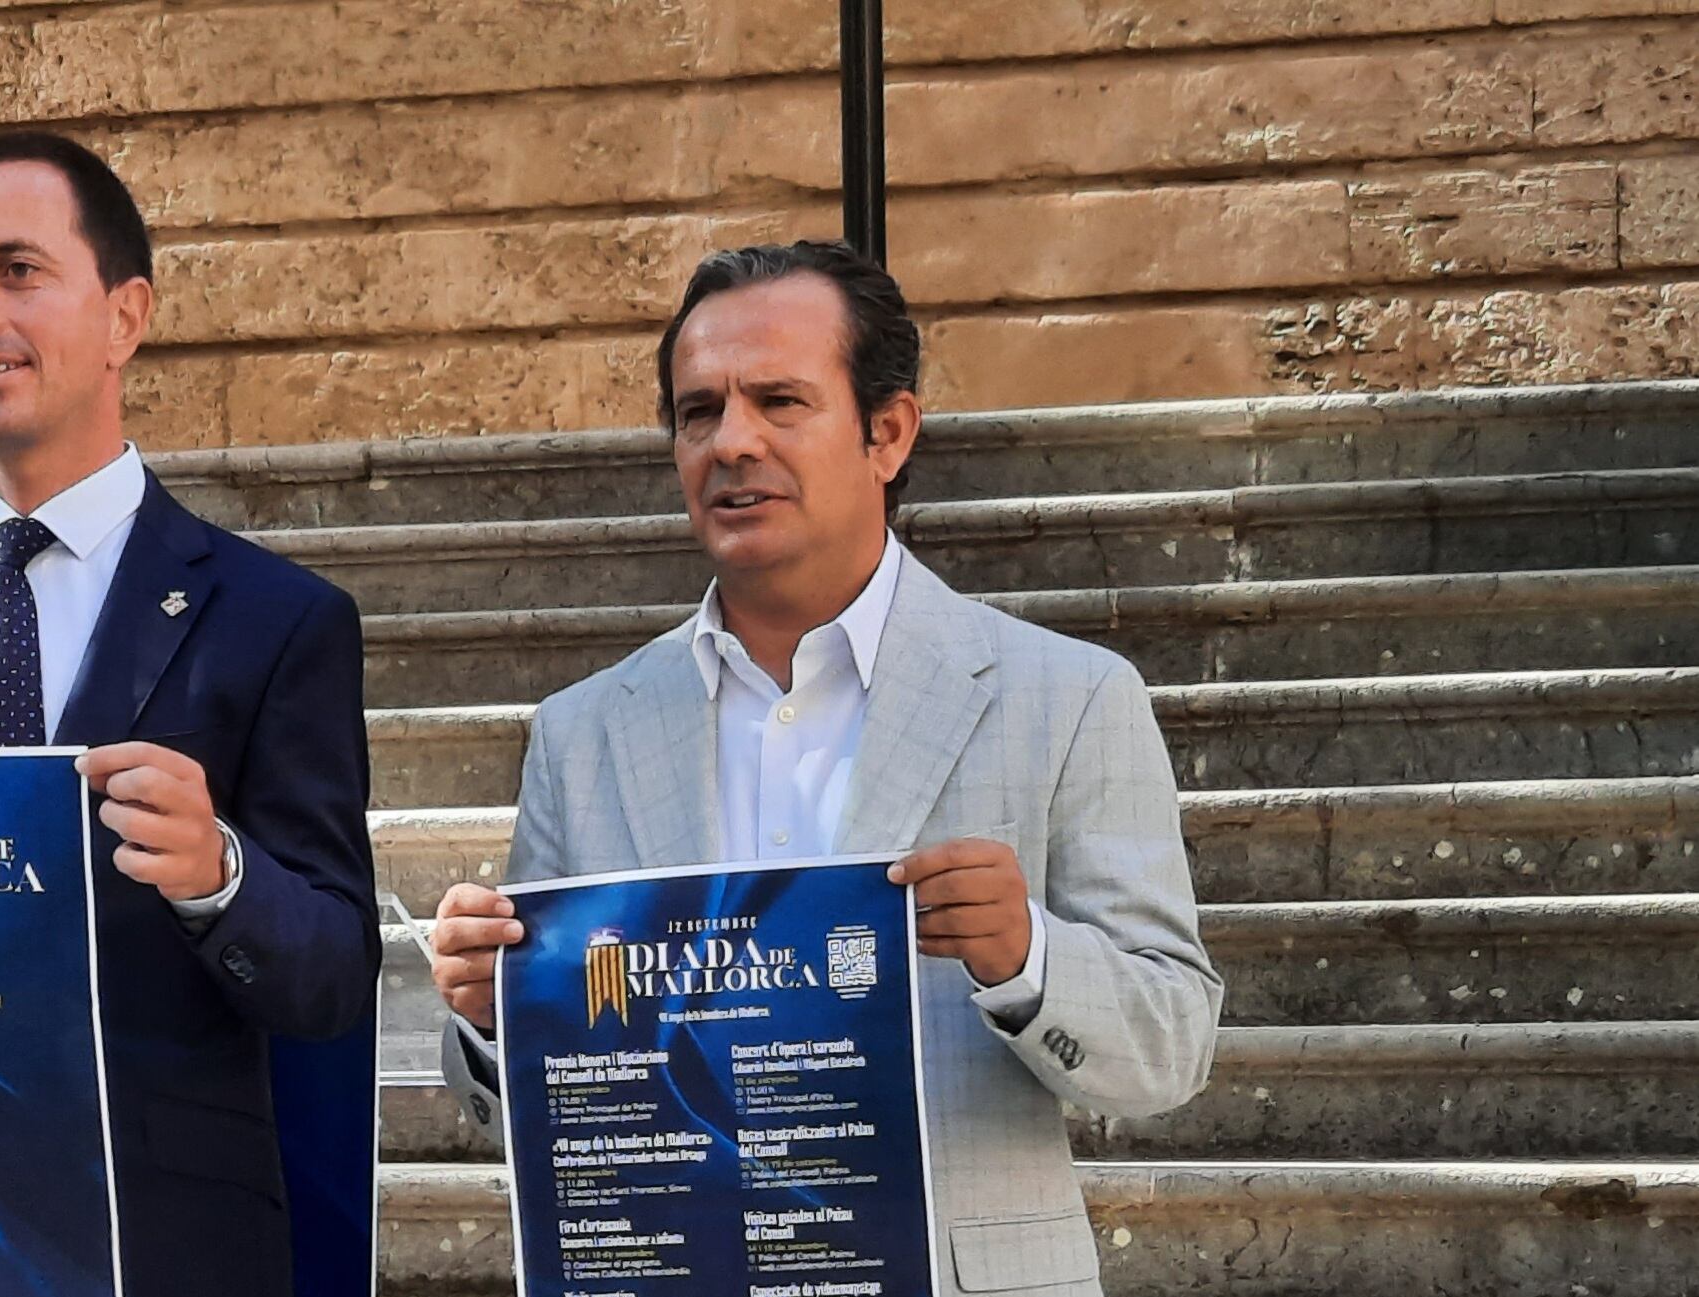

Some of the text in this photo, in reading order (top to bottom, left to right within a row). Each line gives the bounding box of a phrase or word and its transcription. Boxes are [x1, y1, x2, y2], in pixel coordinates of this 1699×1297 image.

[626, 937, 797, 973] DIADA DE
[626, 964, 820, 999] MALLORCA
